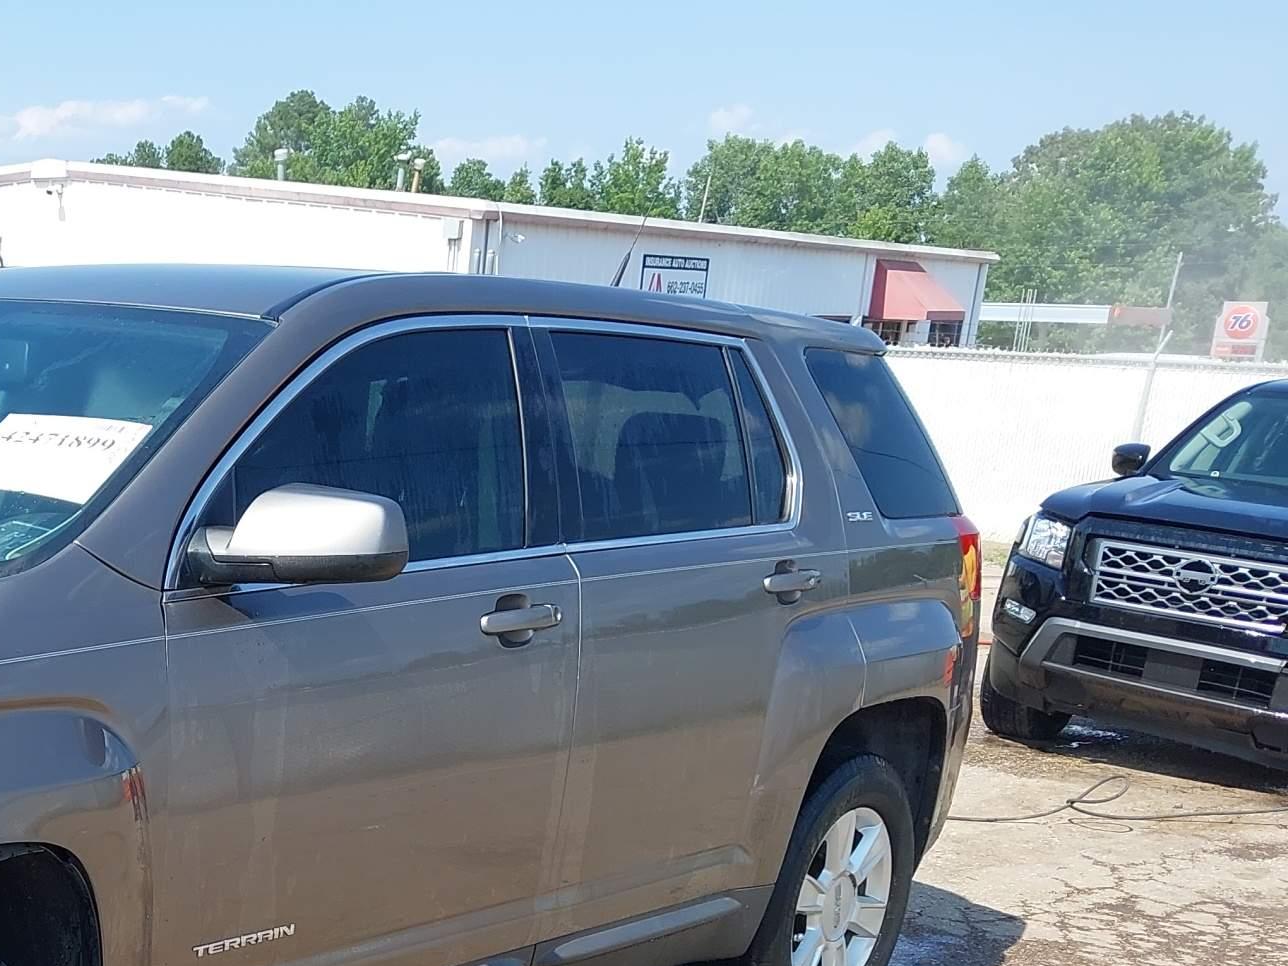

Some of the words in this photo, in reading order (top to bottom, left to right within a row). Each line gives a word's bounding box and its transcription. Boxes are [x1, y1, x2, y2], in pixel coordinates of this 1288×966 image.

[646, 257, 672, 266] INSURANCE
[673, 258, 685, 268] AUTO
[1228, 313, 1254, 331] 76
[847, 511, 873, 521] SLE
[192, 923, 295, 958] TERRAIN
